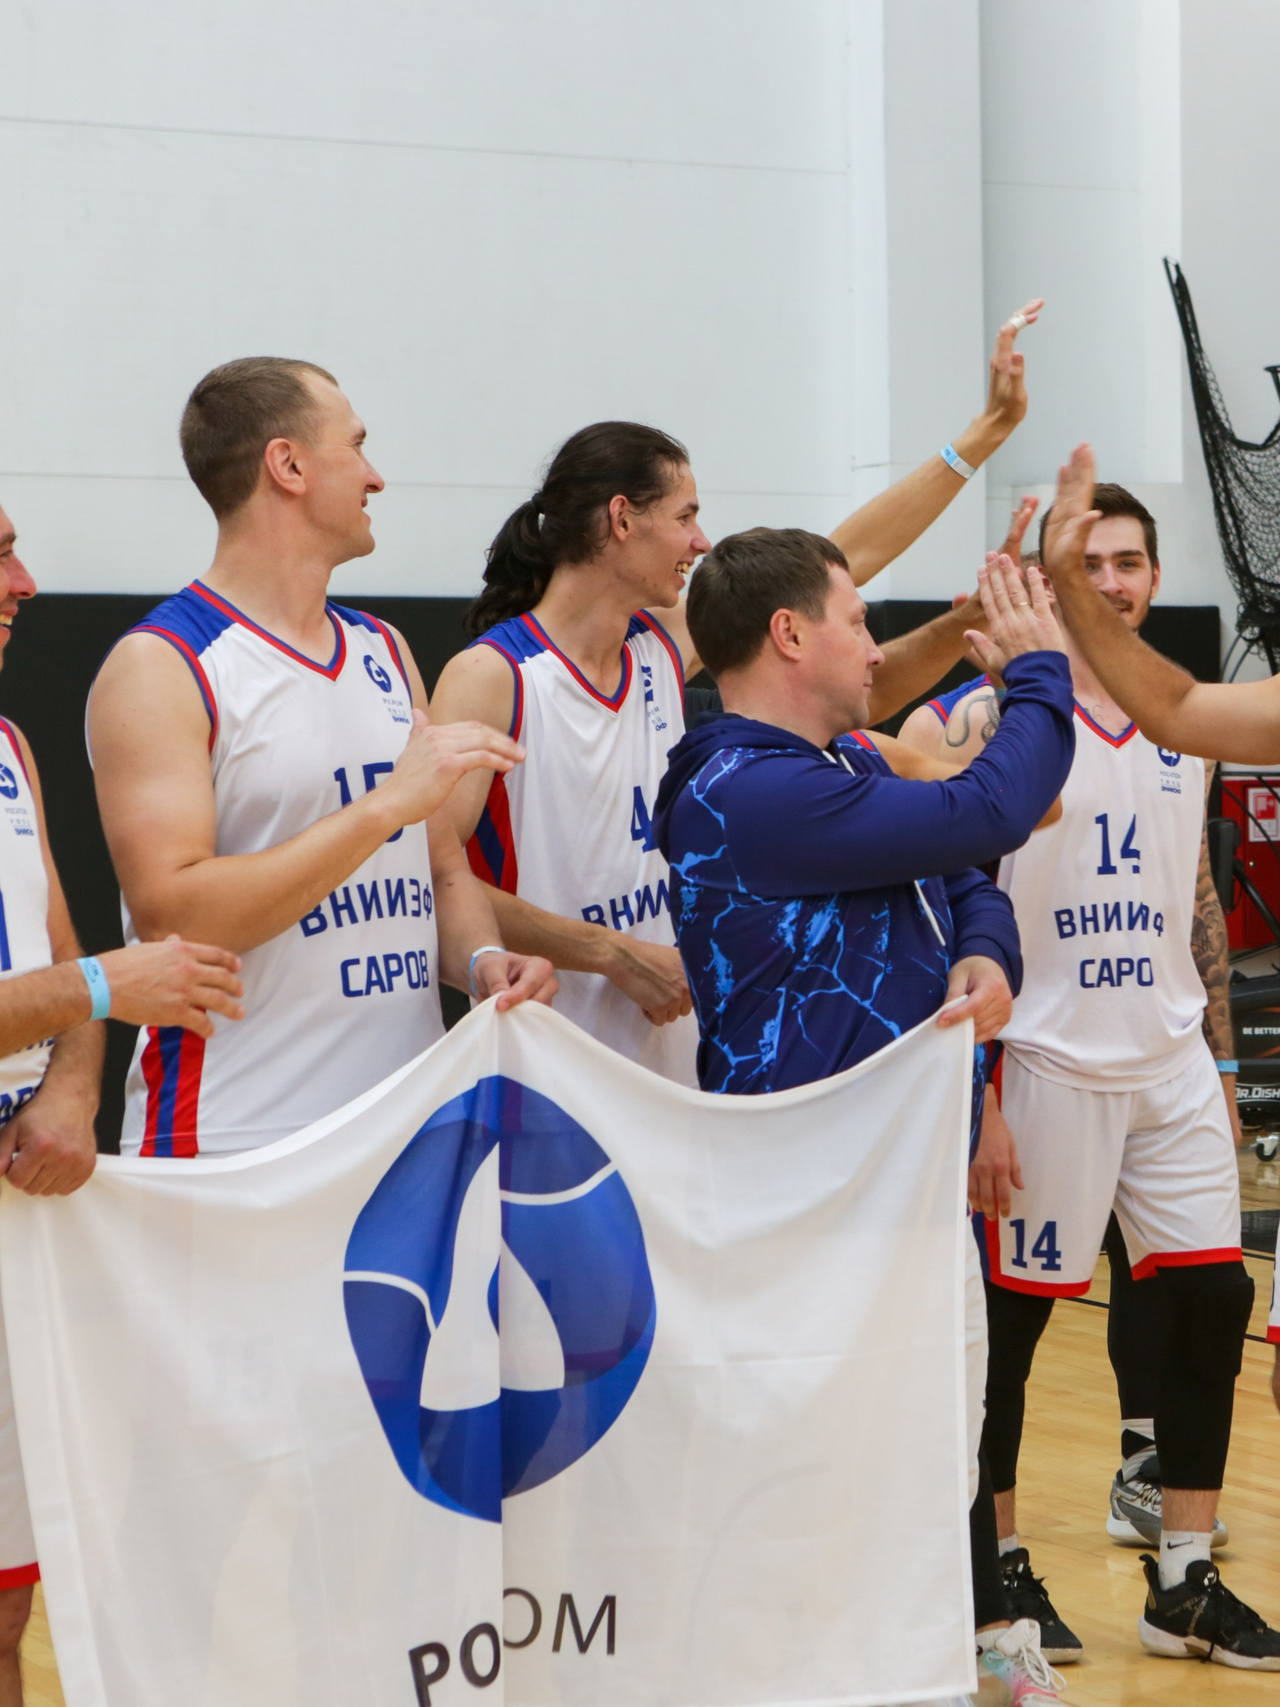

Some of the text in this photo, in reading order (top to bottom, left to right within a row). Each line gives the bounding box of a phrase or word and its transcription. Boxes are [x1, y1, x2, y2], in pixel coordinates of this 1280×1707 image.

[1095, 813, 1141, 875] 14
[300, 878, 432, 938] ВНИИЭФ
[581, 879, 671, 930] ВНИИ
[340, 950, 430, 998] САРОВ
[1079, 957, 1154, 989] САРО
[1242, 1027, 1253, 1035] BE
[1009, 1218, 1062, 1271] 14
